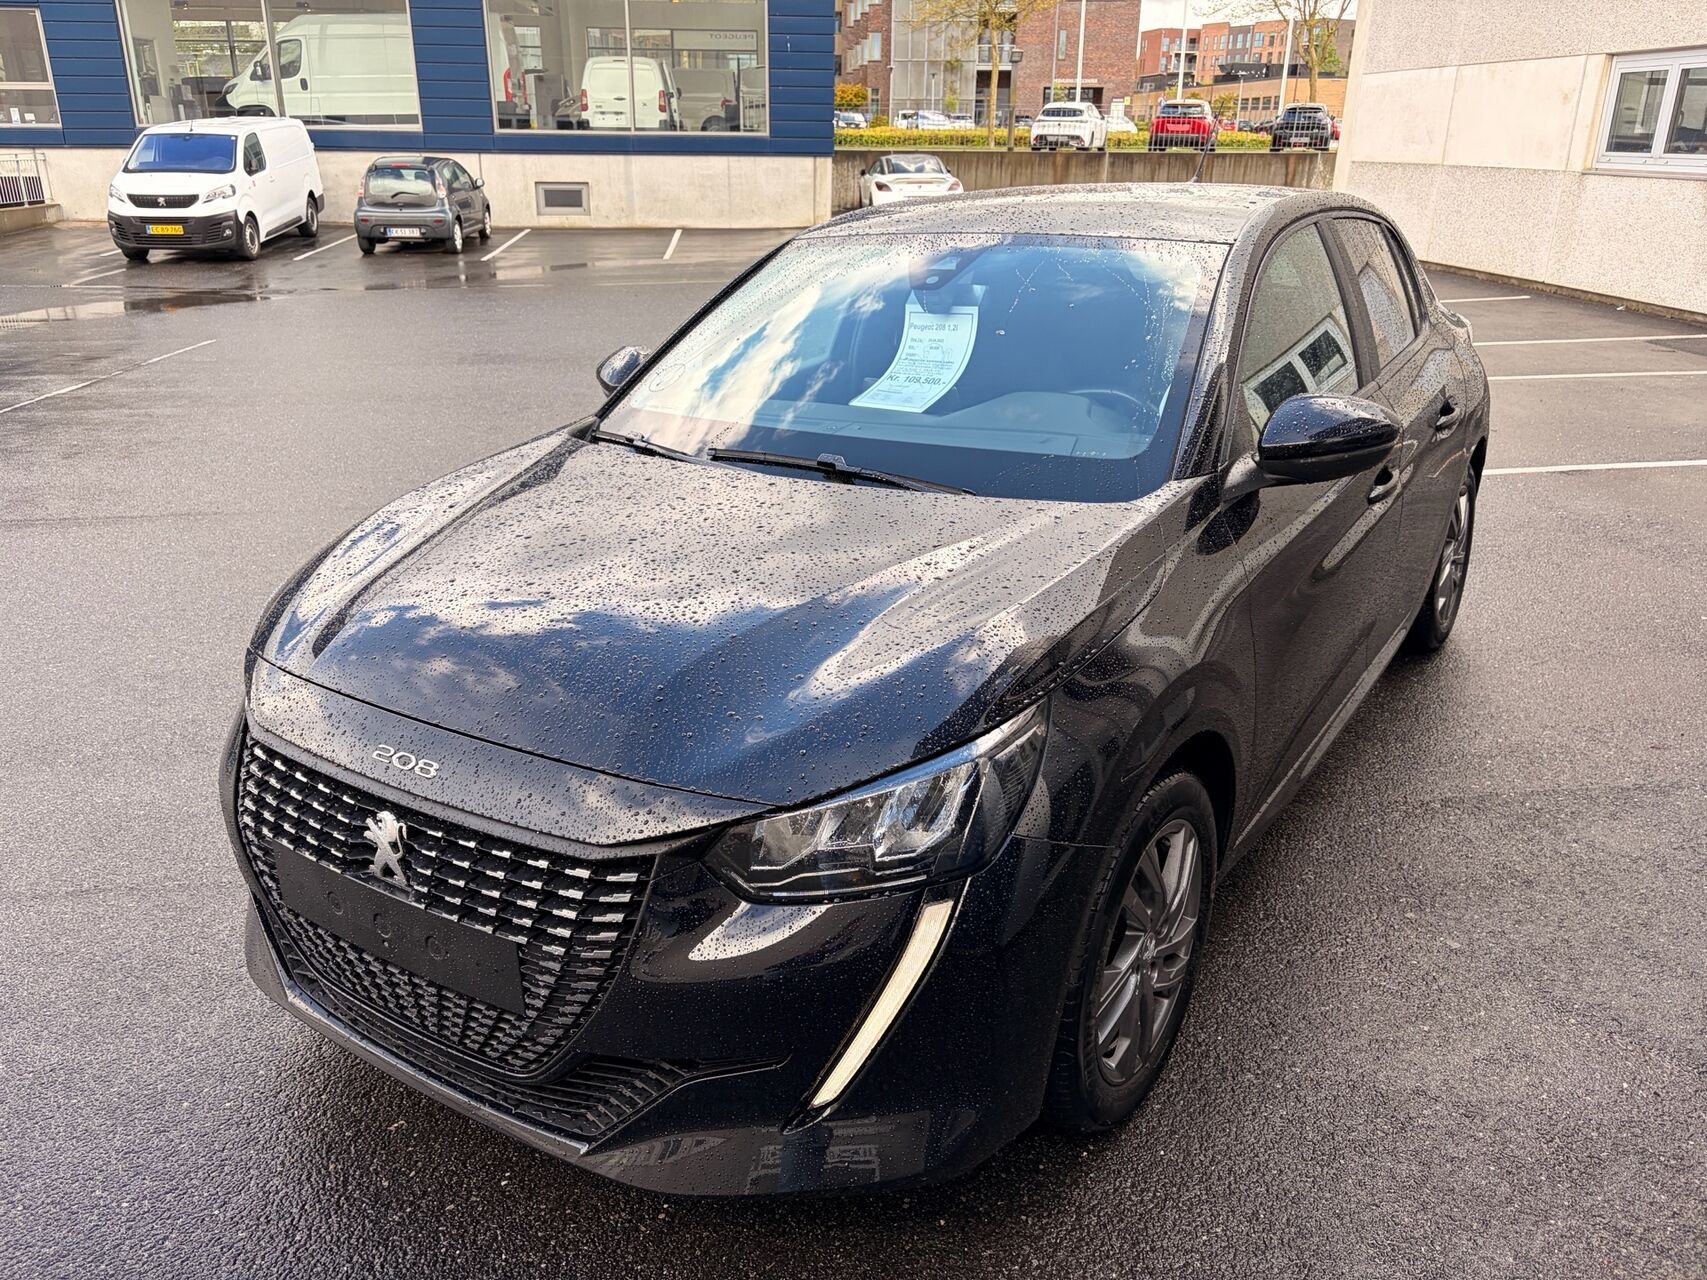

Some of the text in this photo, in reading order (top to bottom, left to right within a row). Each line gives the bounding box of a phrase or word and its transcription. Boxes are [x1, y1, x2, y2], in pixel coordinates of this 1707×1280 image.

[909, 322, 935, 332] Peugeot
[935, 323, 946, 331] 208
[886, 374, 900, 382] Kr.
[372, 744, 440, 779] 208
